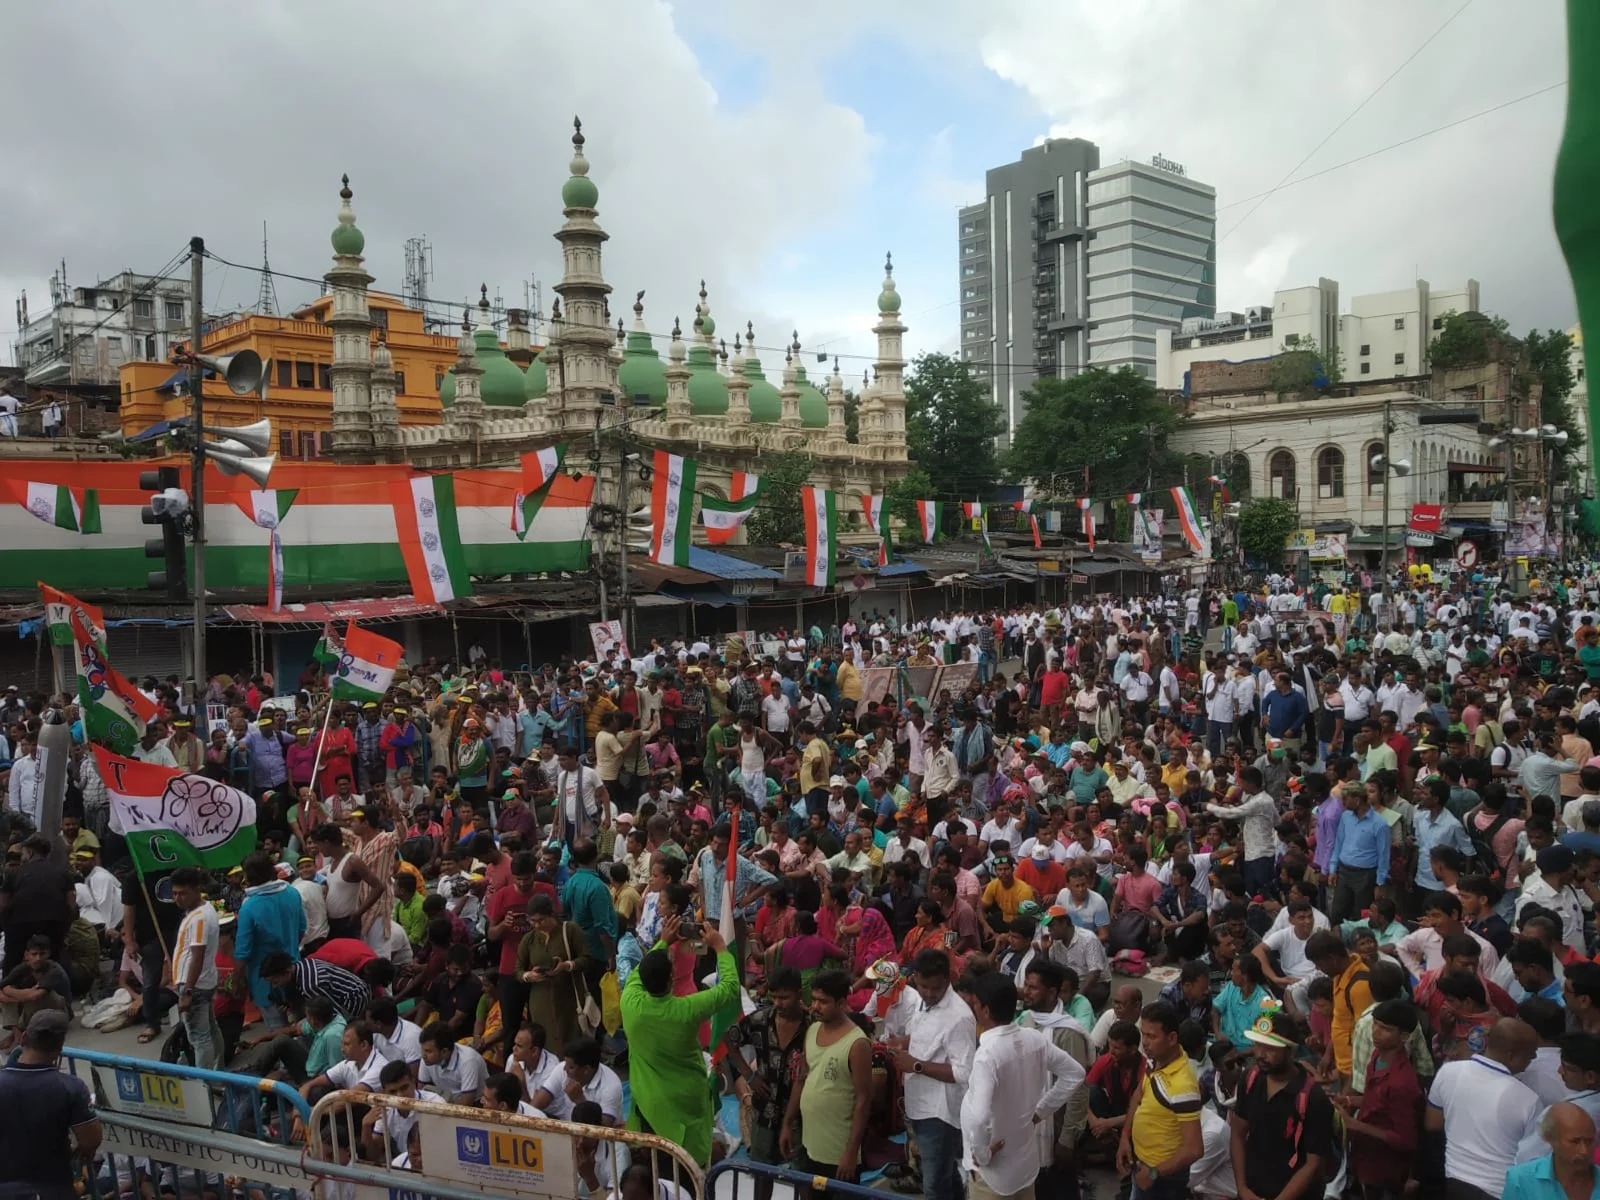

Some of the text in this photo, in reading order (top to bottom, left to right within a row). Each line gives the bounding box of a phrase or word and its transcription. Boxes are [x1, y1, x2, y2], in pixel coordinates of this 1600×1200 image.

[108, 761, 127, 792] T
[150, 834, 177, 863] C
[145, 1076, 179, 1105] LIC
[123, 1126, 224, 1162] TRAFFIC
[494, 1135, 538, 1168] LIC
